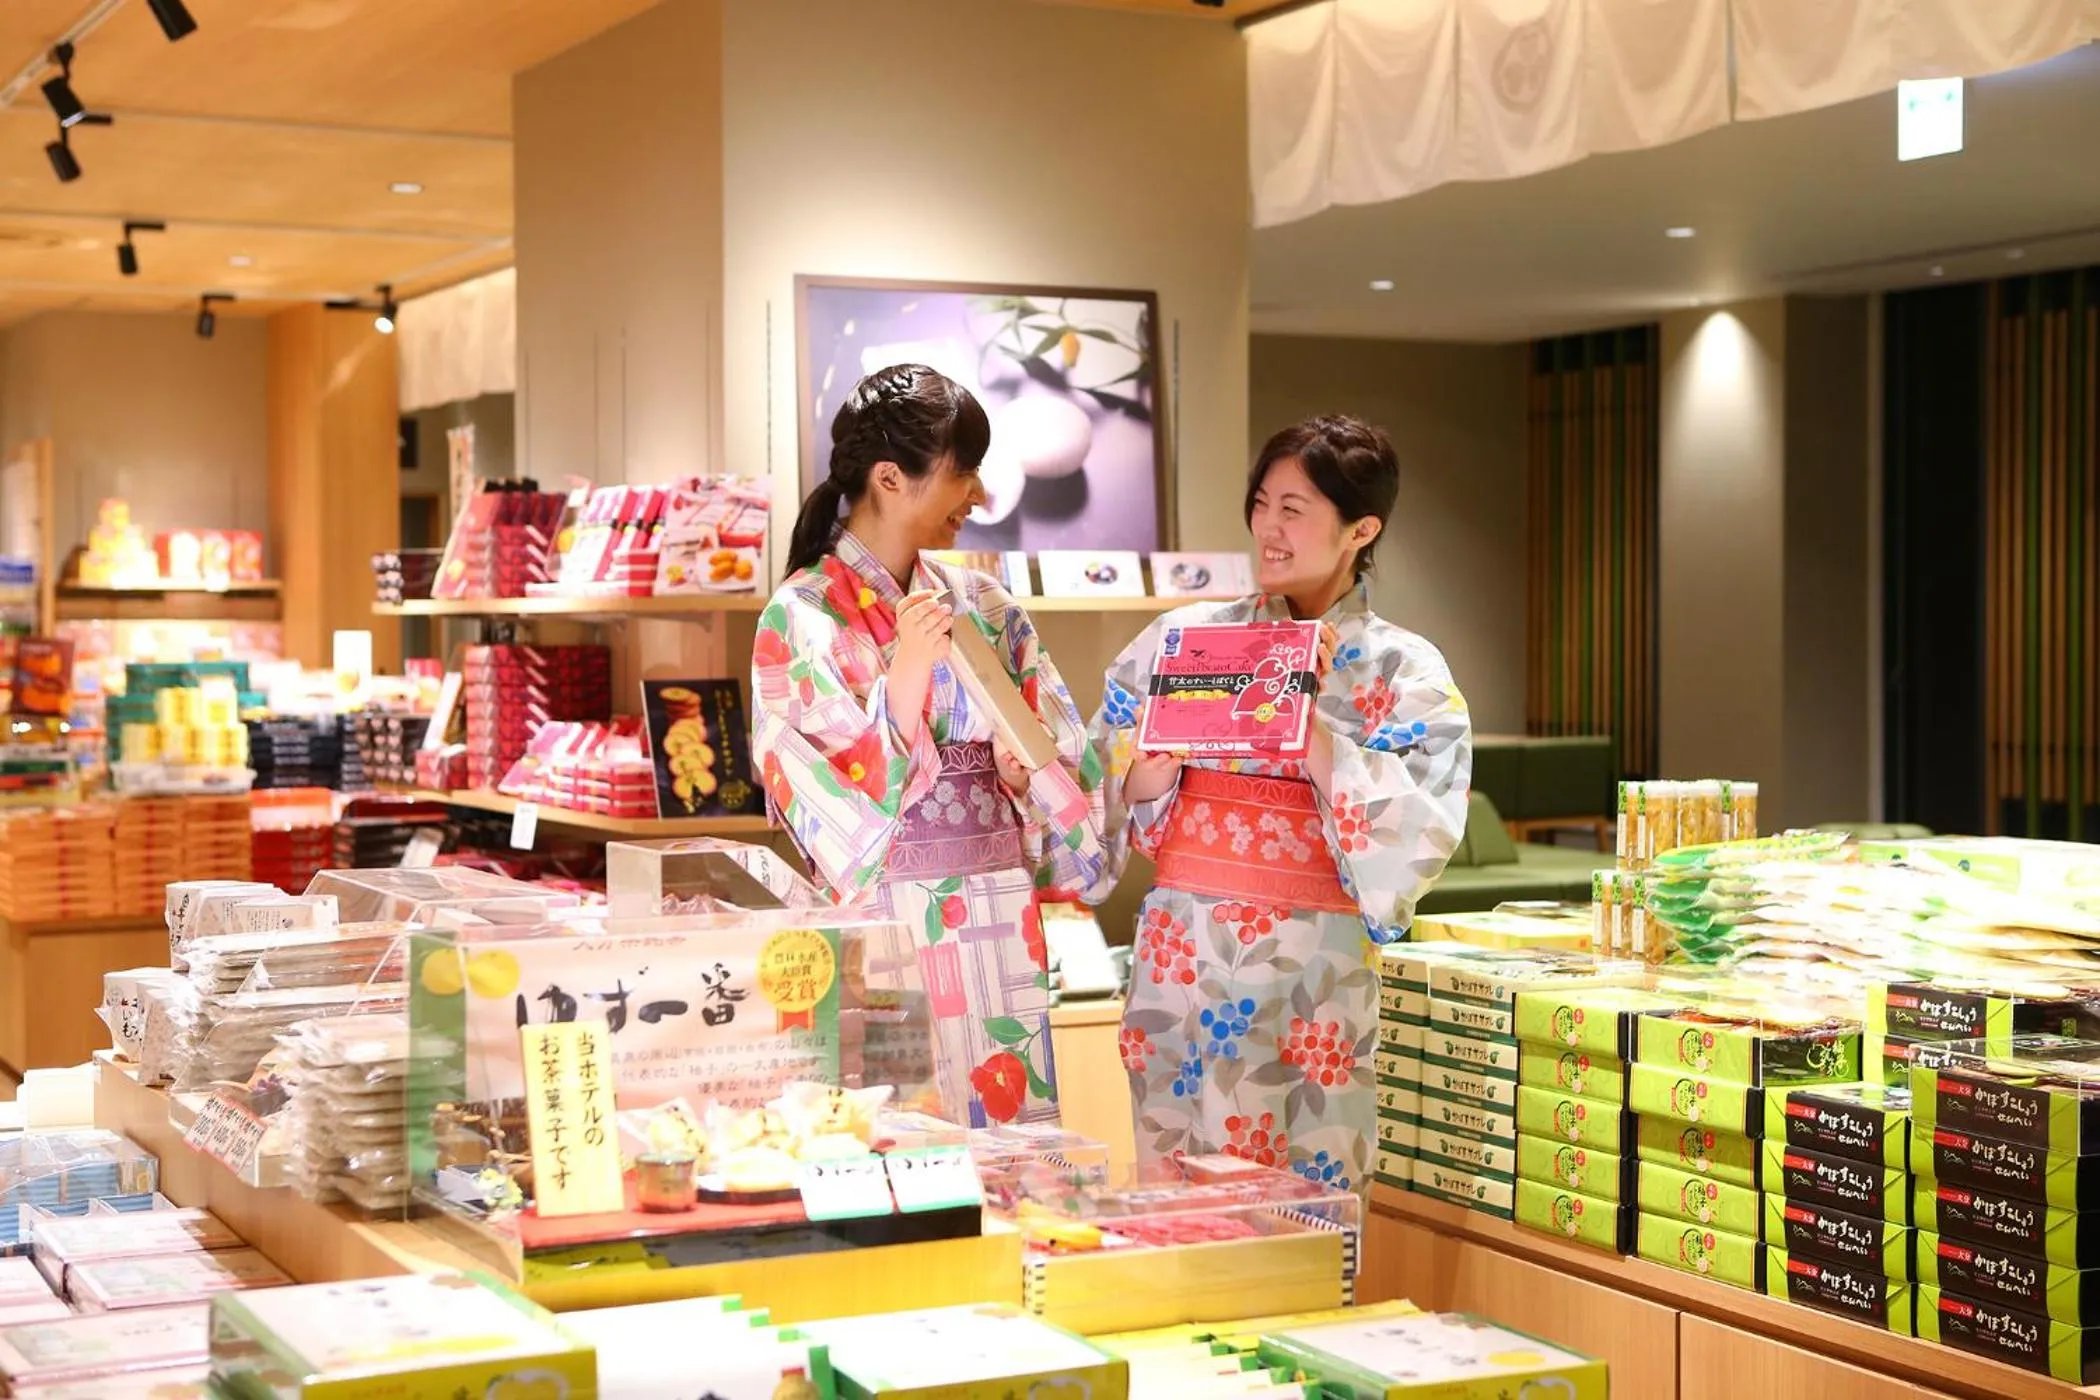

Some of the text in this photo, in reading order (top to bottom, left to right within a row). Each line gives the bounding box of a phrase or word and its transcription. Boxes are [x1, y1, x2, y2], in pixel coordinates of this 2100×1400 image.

[773, 978, 818, 1004] 受賞
[1920, 999, 1977, 1023] かぼすこしょう
[1940, 1021, 1972, 1033] せんべい
[576, 1031, 605, 1147] 当ホテルの
[1975, 1087, 2038, 1117] かぼすこしょう
[537, 1033, 574, 1191] お茶菓子です
[1818, 1110, 1873, 1138] かぼすこしょう
[1997, 1113, 2033, 1126] せんべい
[1838, 1134, 1869, 1147] せんべい
[1972, 1140, 2035, 1170] かぼすこしょう
[1817, 1163, 1873, 1191] かぼすこしょう
[1994, 1166, 2030, 1180] せんべい
[1837, 1187, 1868, 1201] せんべい
[1973, 1196, 2034, 1227] かぼすこしょう
[1817, 1216, 1873, 1246] かぼすこしょう
[1995, 1222, 2030, 1238] せんべい
[1837, 1241, 1868, 1256] せんべい
[1974, 1253, 2036, 1286] かぼすこしょう
[1820, 1269, 1876, 1300] かぼすこしょう
[1997, 1280, 2031, 1296] せんべい
[1840, 1294, 1871, 1309] せんべい
[1976, 1309, 2038, 1342] かぼすこしょう
[1999, 1336, 2033, 1353] せんべい
